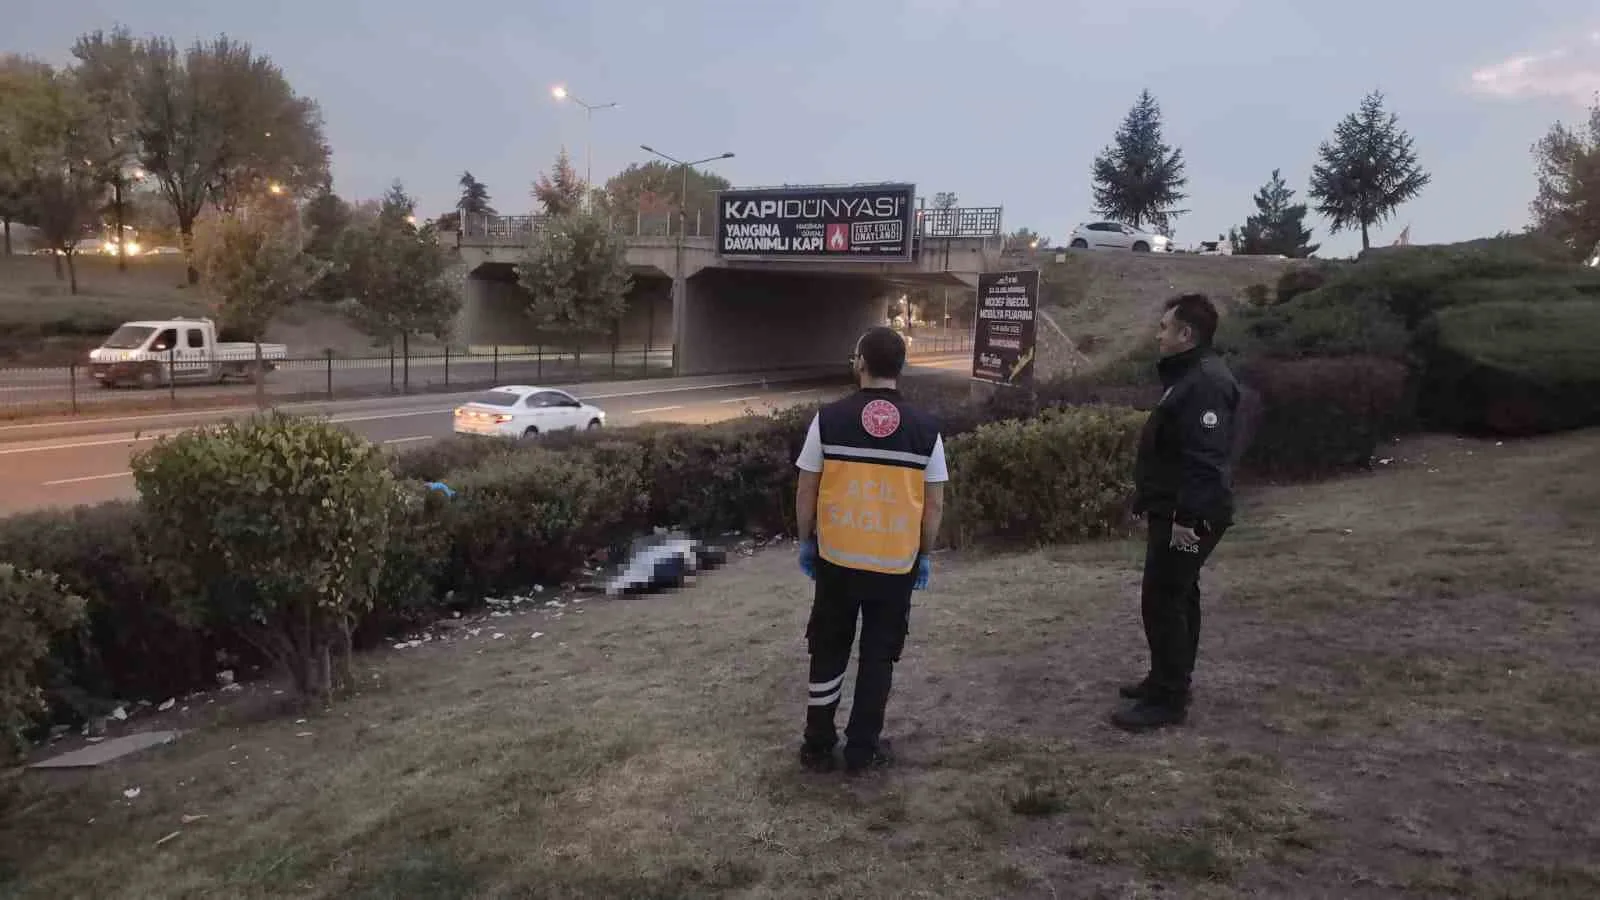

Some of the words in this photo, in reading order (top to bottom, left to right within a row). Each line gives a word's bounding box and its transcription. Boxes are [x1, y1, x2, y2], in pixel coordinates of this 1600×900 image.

[725, 223, 780, 237] YANGINA
[724, 237, 790, 250] DAYANIMLI
[792, 237, 824, 250] KAPI
